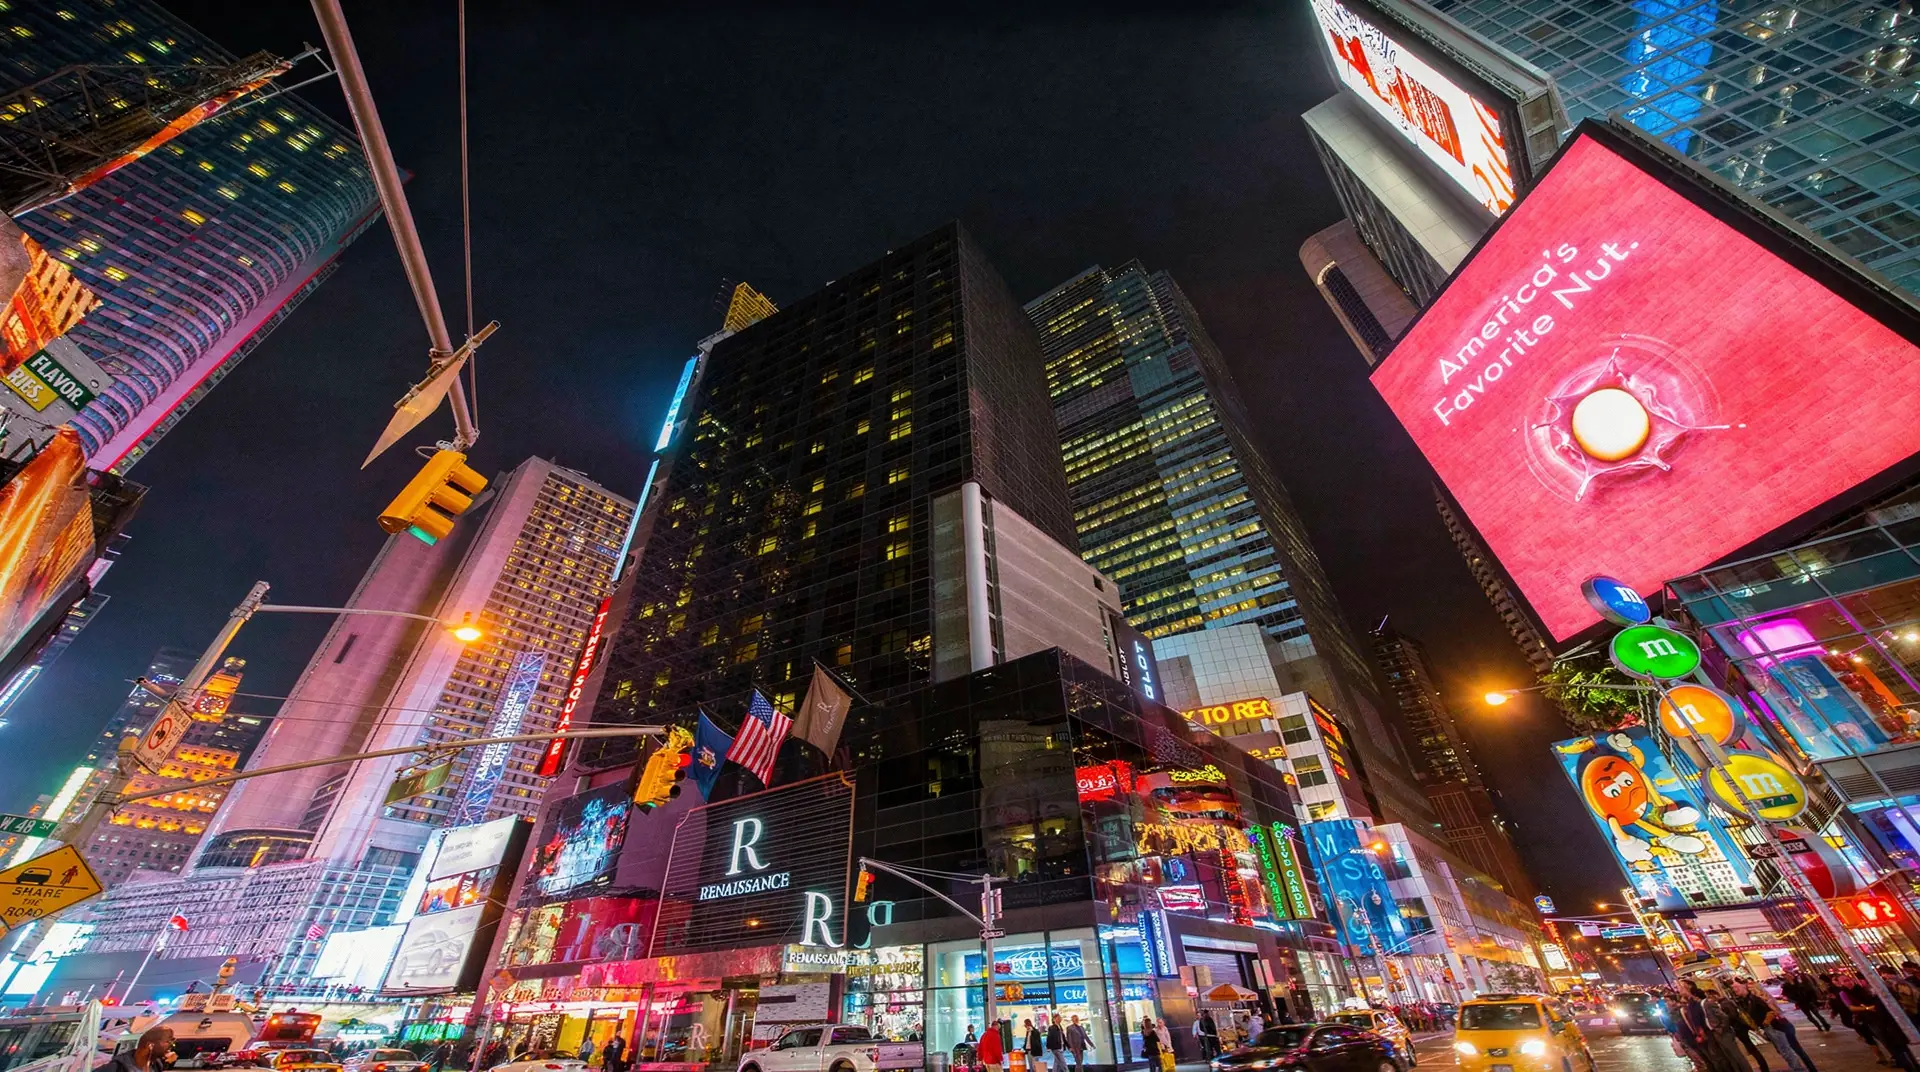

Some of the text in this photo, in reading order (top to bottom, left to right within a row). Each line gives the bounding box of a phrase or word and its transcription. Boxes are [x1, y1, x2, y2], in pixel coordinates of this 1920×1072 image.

[1438, 242, 1578, 385] America's
[1432, 241, 1640, 427] Favorite Nut.
[30, 354, 84, 406] FLAVOR.
[1613, 585, 1644, 606] m
[579, 611, 608, 671] TIMES
[1637, 638, 1679, 660] m
[1198, 705, 1230, 726] TO
[475, 719, 508, 780] AMERIAN
[1739, 771, 1786, 796] m
[0, 816, 16, 832] W
[14, 819, 37, 834] 48
[725, 817, 771, 876] R
[12, 885, 65, 899] SHARE
[699, 871, 791, 901] RENAISSANCE
[3, 905, 45, 918] ROAD
[22, 897, 44, 907] THE
[798, 891, 845, 949] R
[1031, 956, 1084, 972] EXHAN
